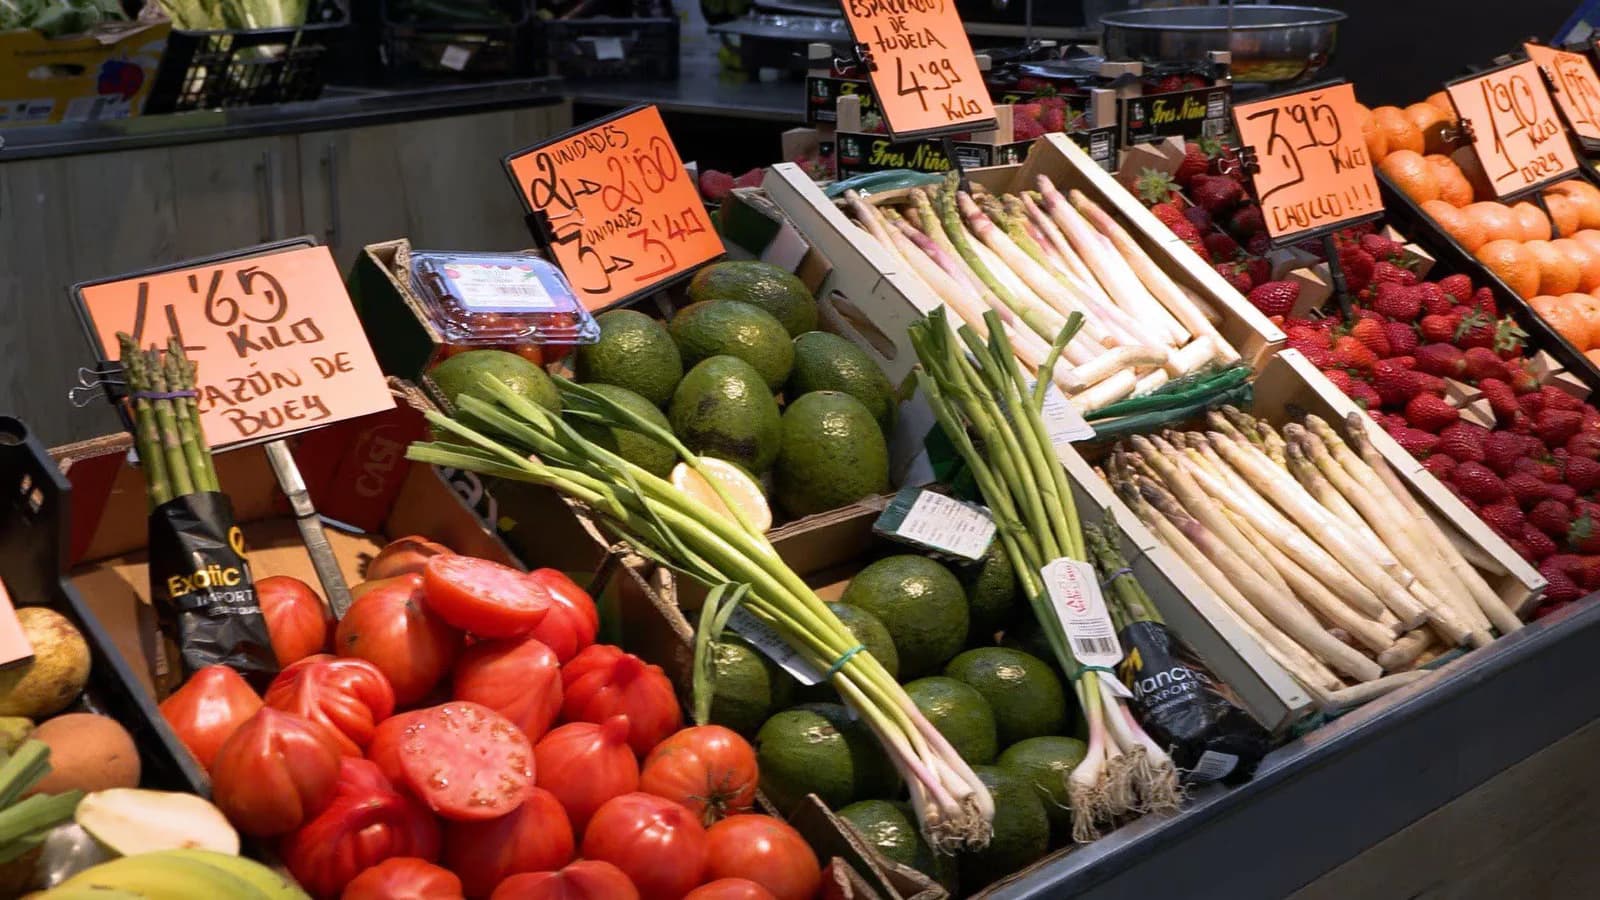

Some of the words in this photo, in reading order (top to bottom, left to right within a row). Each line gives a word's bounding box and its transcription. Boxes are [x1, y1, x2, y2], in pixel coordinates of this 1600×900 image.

[888, 16, 909, 33] DE
[896, 57, 962, 112] 4'99
[1150, 99, 1175, 125] Fres
[1480, 75, 1537, 182] 1'90
[552, 125, 629, 166] UNIDADES
[602, 136, 677, 211] 2'50
[868, 140, 904, 167] Fres
[1246, 94, 1341, 205] 3'95
[551, 230, 611, 294] 3
[585, 207, 642, 245] UNIDADES
[627, 207, 706, 282] 3'40
[132, 265, 288, 354] 4'65
[310, 352, 354, 379] DE
[221, 395, 332, 437] BUEY
[167, 564, 241, 597] Exotic
